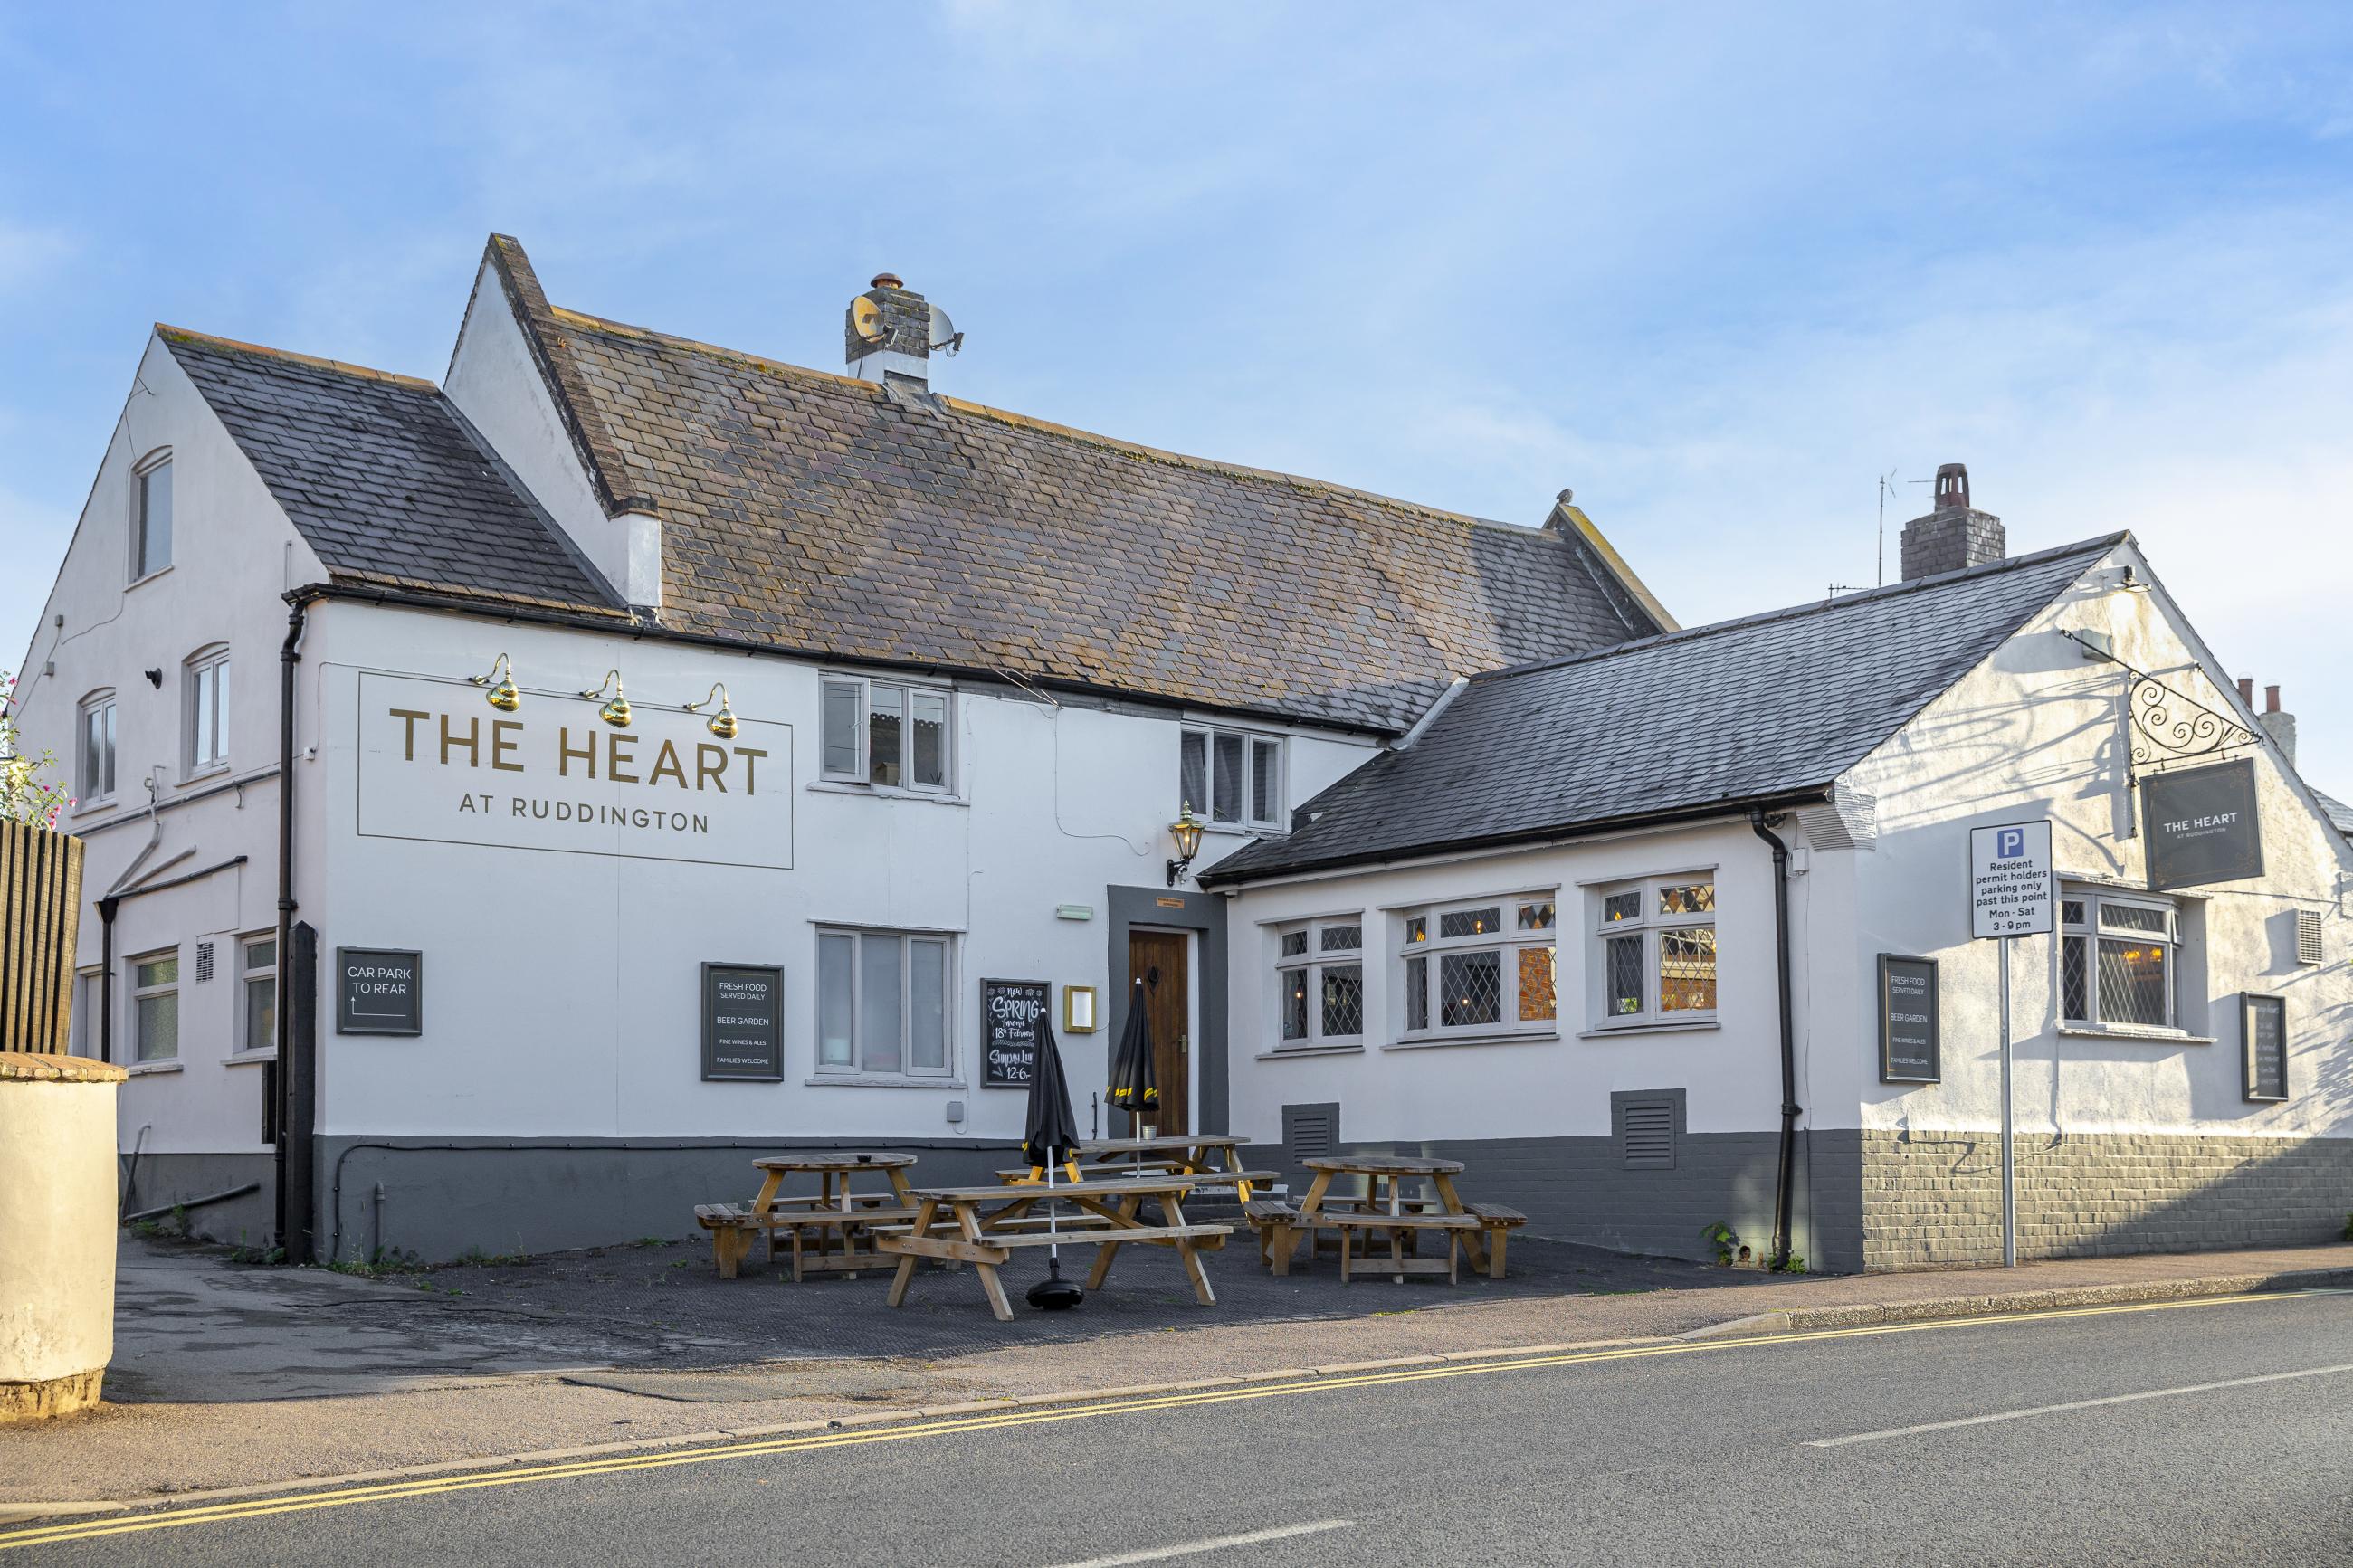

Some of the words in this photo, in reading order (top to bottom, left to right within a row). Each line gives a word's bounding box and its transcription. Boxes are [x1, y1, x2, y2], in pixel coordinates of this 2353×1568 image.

[389, 708, 525, 773] THE
[559, 727, 768, 795] HEART
[459, 794, 494, 814] AT
[511, 797, 709, 833] RUDDINGTON
[2163, 820, 2189, 833] THE
[2194, 812, 2238, 829] HEART
[2004, 832, 2019, 856] P
[1990, 859, 2033, 871] Resident
[1976, 873, 2007, 886] permit
[2010, 870, 2047, 881] holders
[1981, 884, 2018, 896] parking
[2021, 881, 2042, 891] only
[1977, 897, 1997, 908] past
[2000, 894, 2019, 904] this
[2022, 891, 2047, 903] point
[1989, 909, 2010, 918] Mon
[2018, 907, 2035, 917] Sat
[1993, 922, 2000, 931] 3
[2007, 921, 2014, 929] 9
[2015, 921, 2031, 930] pm
[348, 966, 375, 978] CAR
[377, 967, 412, 979] PARK
[1891, 975, 1909, 984] FRESH
[1909, 977, 1926, 986] FOOD
[352, 983, 371, 993] TO
[374, 984, 406, 994] REAR
[719, 982, 743, 991] FRESH
[745, 984, 767, 992] FOOD
[1892, 986, 1910, 994] SERVED
[720, 992, 746, 1000] SERVED
[717, 1016, 736, 1024] BEER
[737, 1018, 769, 1026] GARDEN
[1890, 1012, 1904, 1022] BEER
[1904, 1013, 1928, 1023] GARDEN
